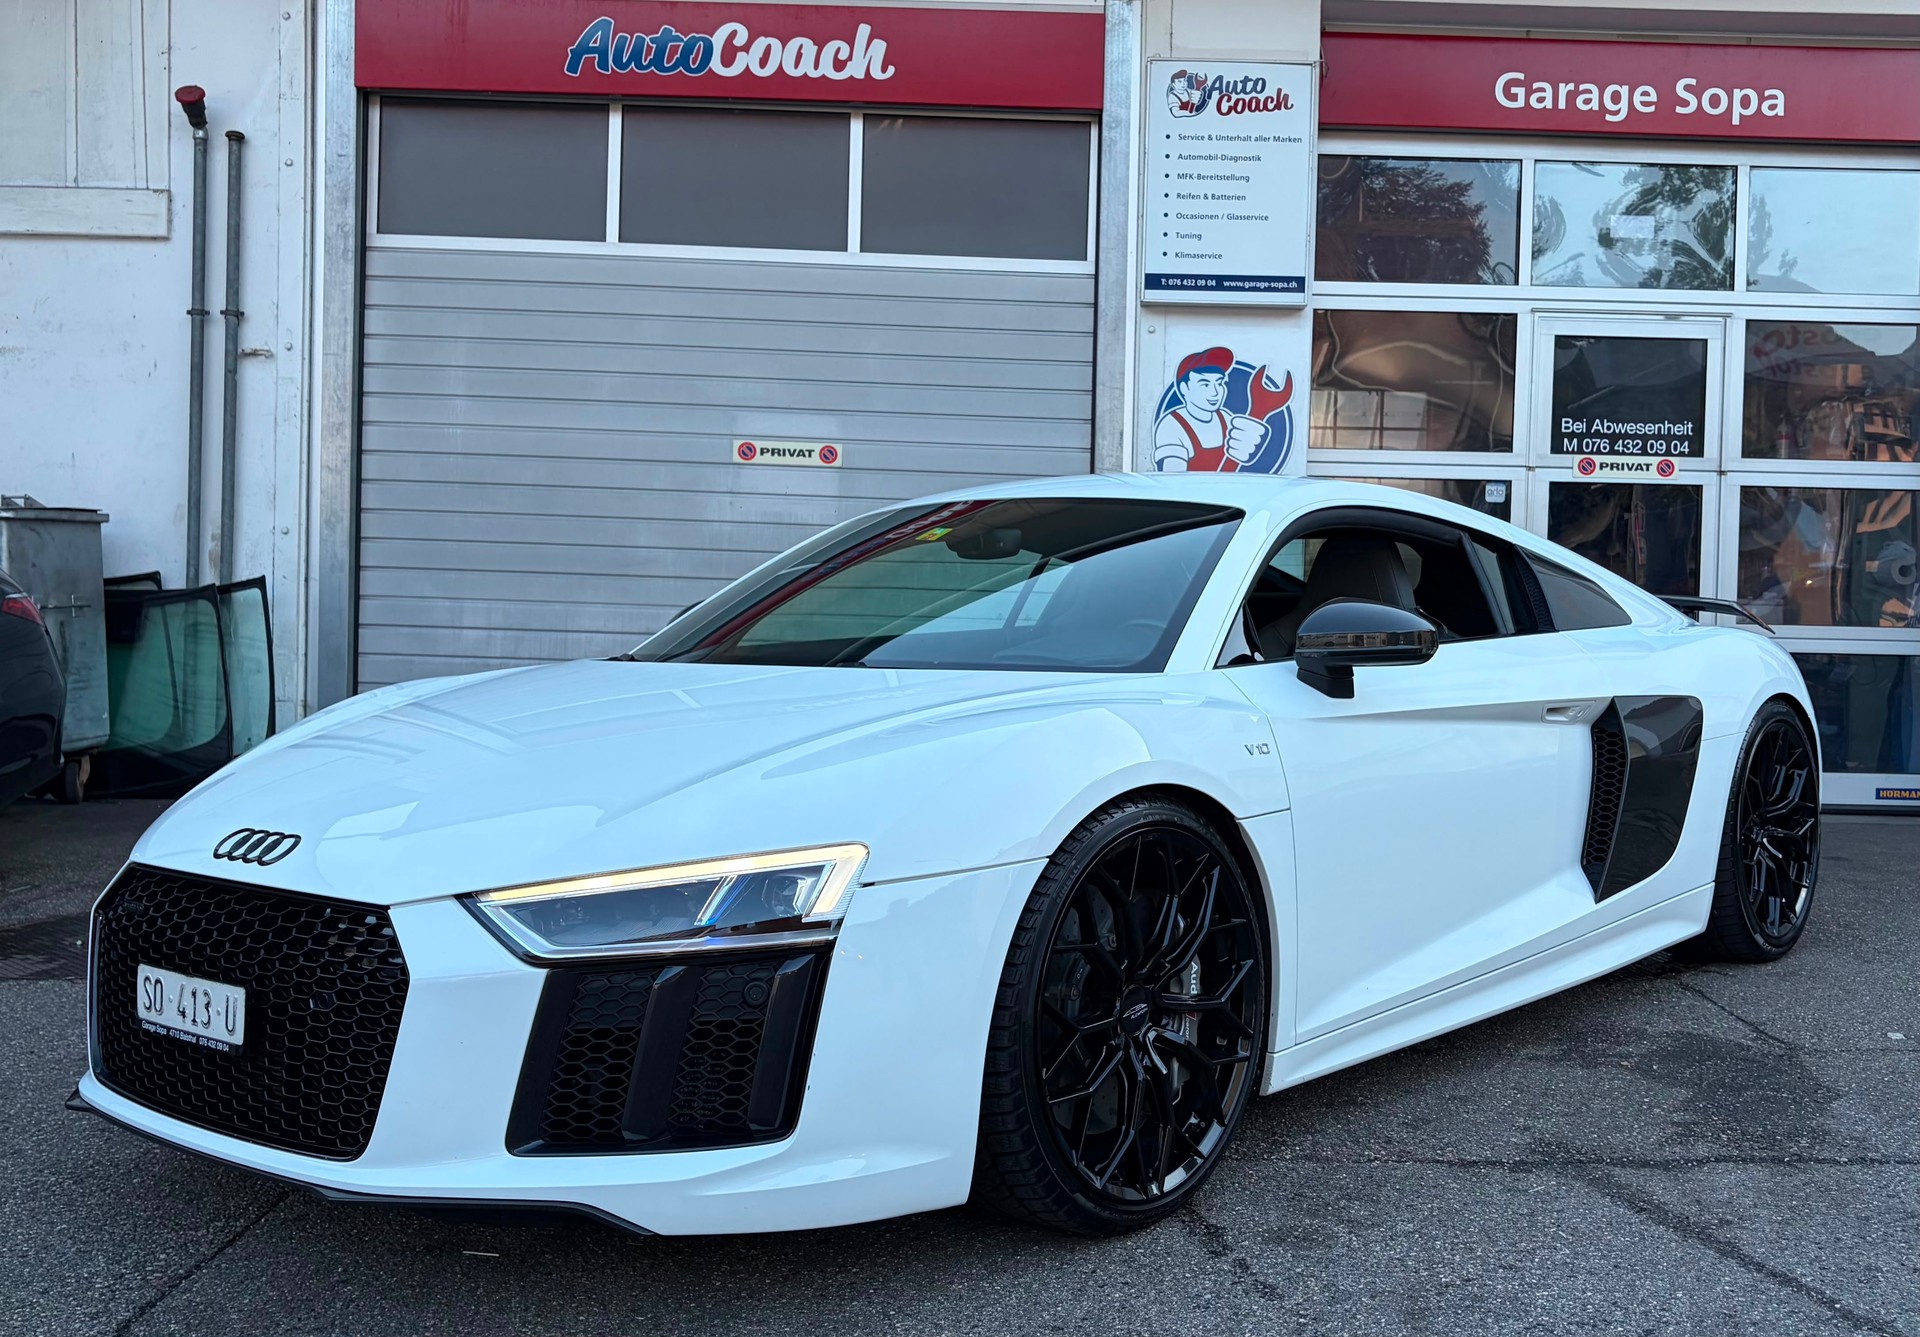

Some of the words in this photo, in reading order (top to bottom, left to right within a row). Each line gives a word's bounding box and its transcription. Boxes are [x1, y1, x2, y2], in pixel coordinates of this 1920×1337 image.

[564, 16, 895, 80] AutoCoach
[1207, 74, 1267, 100] Auto
[1216, 87, 1294, 116] Coach
[1494, 71, 1658, 122] Garage
[1675, 77, 1786, 126] Sopa
[1178, 133, 1206, 142] Service
[1207, 134, 1213, 142] &
[1215, 134, 1252, 143] Unterhalt
[1254, 135, 1271, 143] aller
[1273, 135, 1303, 144] Marken
[1177, 153, 1262, 163] Automobil-Diagnostik
[1177, 173, 1250, 183] MFK-Bereitstellung
[1176, 192, 1201, 201] Reifen
[1203, 193, 1209, 201] &
[1211, 193, 1247, 202] Batterien
[1175, 212, 1220, 221] Occasionen
[1226, 213, 1270, 222] Glasservice
[1175, 231, 1202, 241] Tuning
[1174, 251, 1223, 260] Klimaservice
[1160, 278, 1167, 286] T:
[1182, 279, 1196, 287] 432
[1197, 279, 1206, 287] 09
[1223, 280, 1298, 289] www.garage-sopa.ch
[1561, 418, 1587, 433] Bei
[1591, 418, 1694, 436] Abwesenheit
[759, 447, 815, 458] PRIVAT
[1563, 438, 1578, 452] M
[1582, 438, 1610, 453] 076
[1614, 439, 1642, 454] 432
[1647, 440, 1666, 454] 09
[1670, 440, 1690, 455] 04
[1599, 462, 1653, 472] PRIVAT
[1244, 742, 1270, 756] V10
[1189, 961, 1198, 994] Aud
[143, 973, 164, 1016] SO
[177, 982, 212, 1029] 413
[225, 993, 239, 1036] U
[142, 1020, 156, 1033] Garage
[156, 1024, 167, 1035] Sopa
